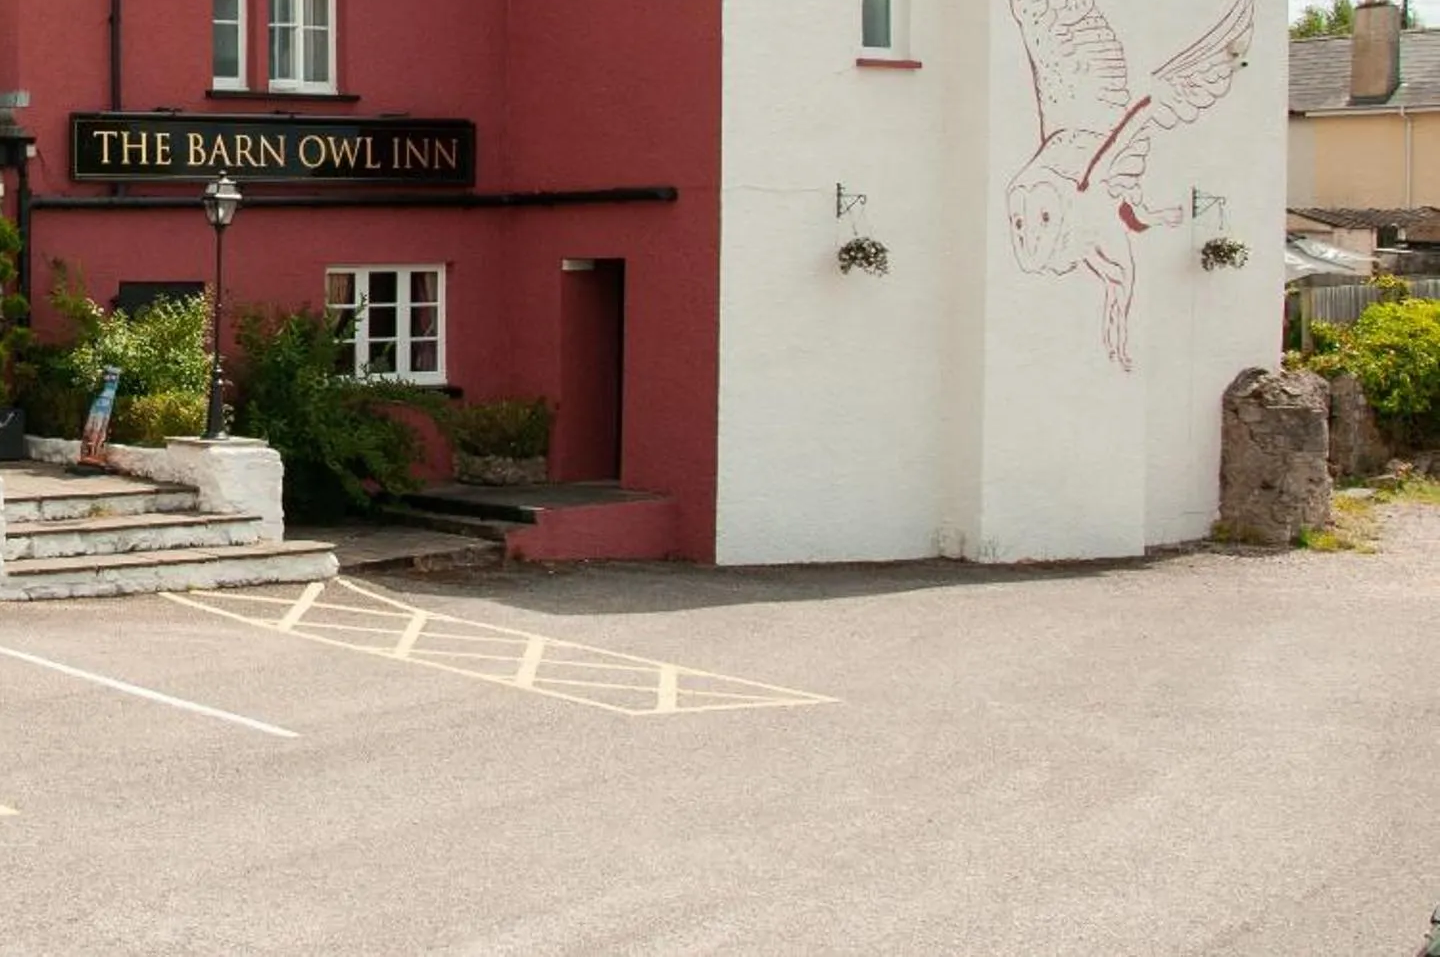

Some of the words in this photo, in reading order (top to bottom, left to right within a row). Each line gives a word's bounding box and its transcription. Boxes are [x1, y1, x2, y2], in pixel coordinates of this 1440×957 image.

[93, 130, 172, 165] THE
[186, 132, 286, 167] BARN
[298, 134, 382, 169] OWL
[392, 136, 459, 170] INN
